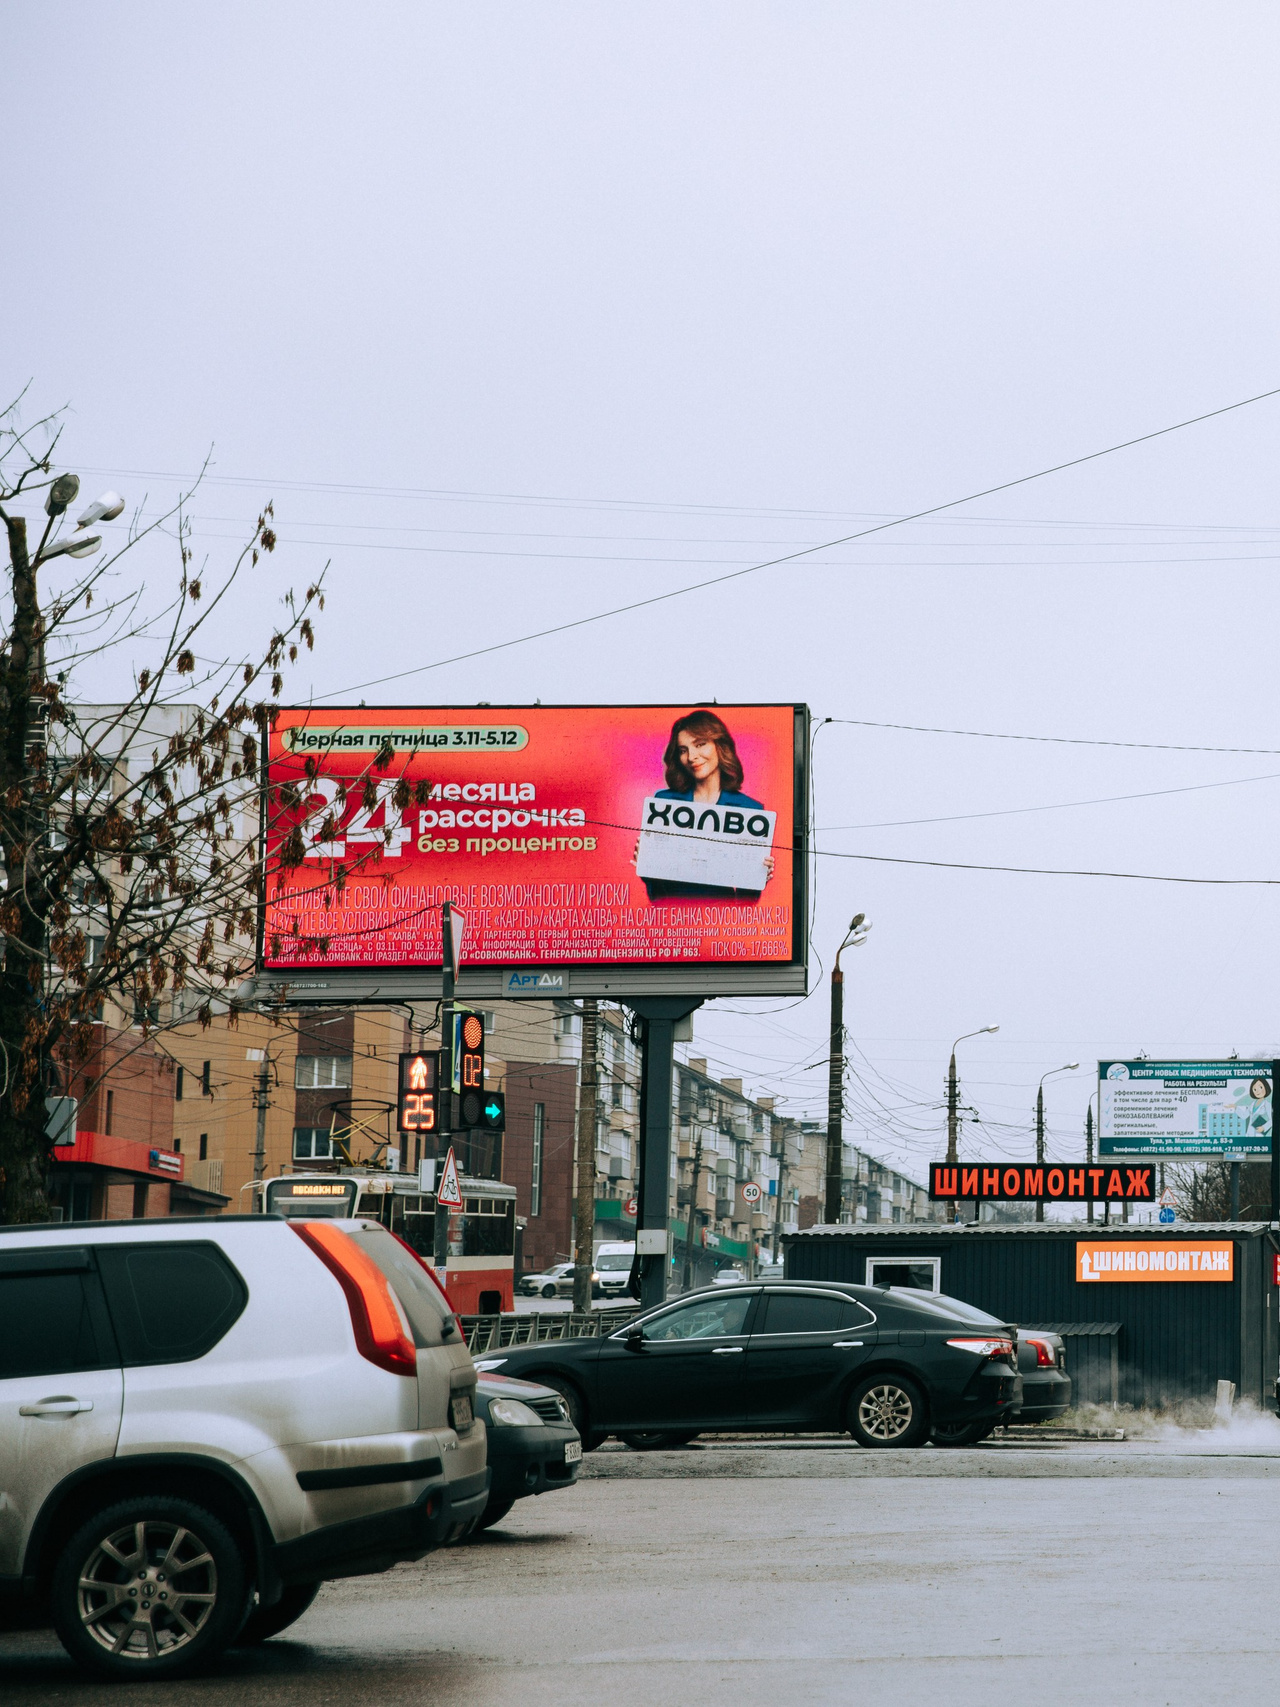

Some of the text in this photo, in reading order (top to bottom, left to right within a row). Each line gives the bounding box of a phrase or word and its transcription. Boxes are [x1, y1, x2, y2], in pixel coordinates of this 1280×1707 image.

[295, 730, 518, 750] Черная пятница 3.11-5.12
[297, 778, 412, 858] 24
[418, 807, 586, 833] рассрочка
[418, 834, 460, 853] без
[390, 884, 478, 909] ФИНАНСОВЫЕ
[481, 883, 575, 908] ВОЗМОЖНОСТИ
[577, 883, 587, 907] И
[589, 883, 630, 907] РИСКИ
[318, 911, 338, 931] ВСЕ
[340, 910, 390, 931] УСЛОВИЯ
[391, 910, 437, 932] КРЕДИТА
[580, 907, 618, 928] ХАЛВА»
[620, 907, 634, 927] НА
[635, 905, 669, 927] САЙТЕ
[670, 906, 703, 927] БАНКА
[704, 905, 789, 926] SOVCOMBANK.RU
[360, 931, 386, 941] КАРТЫ
[423, 931, 434, 940] НА
[475, 930, 480, 940] У
[483, 929, 527, 939] ПАРТНЕРОВ
[529, 929, 535, 939] В
[537, 927, 569, 939] ПЕРВЫЙ
[572, 927, 613, 938] ОТЧЕТНЫЙ
[615, 928, 646, 938] ПЕРИОД
[648, 928, 664, 938] ПРИ
[667, 927, 720, 937] ВЫПОЛНЕНИИ
[722, 926, 757, 936] УСЛОВИЙ
[367, 942, 373, 951] С
[375, 941, 398, 951] 03.11.
[401, 941, 413, 950] ПО
[461, 940, 480, 951] ОДА.
[482, 940, 536, 951] ИНФОРМАЦИЯ
[538, 939, 549, 949] ОБ
[551, 938, 609, 949] ОРГАНИЗАТОРЕ,
[611, 938, 650, 948] ПРАВИЛАХ
[653, 937, 701, 948] ПРОВЕДЕНИЯ
[710, 941, 731, 957] ПСК
[297, 952, 308, 962] НА
[308, 952, 374, 962] SOVCOMBANK.RU
[375, 951, 408, 963] (РАЗДЕЛ
[470, 949, 539, 960] «СОВКОМБАНК».
[540, 949, 598, 959] ГЕНЕРАЛЬНАЯ
[600, 947, 644, 959] ЛИЦЕНЗИЯ
[645, 947, 657, 959] ЦБ
[658, 947, 671, 957] РФ
[683, 947, 701, 957] 963.
[463, 1053, 482, 1087] 02
[1132, 1068, 1272, 1077] ЦЕНТР НОВЫХ МЕДИЦИНСКИХ ТЕХНОЛОГИ
[402, 1093, 435, 1130] 25
[934, 1168, 1151, 1196] ШИНОМОНТАЖ
[746, 1188, 758, 1197] 50
[629, 1201, 638, 1214] 5
[1093, 1250, 1230, 1271] ШИНОМОНТАЖ
